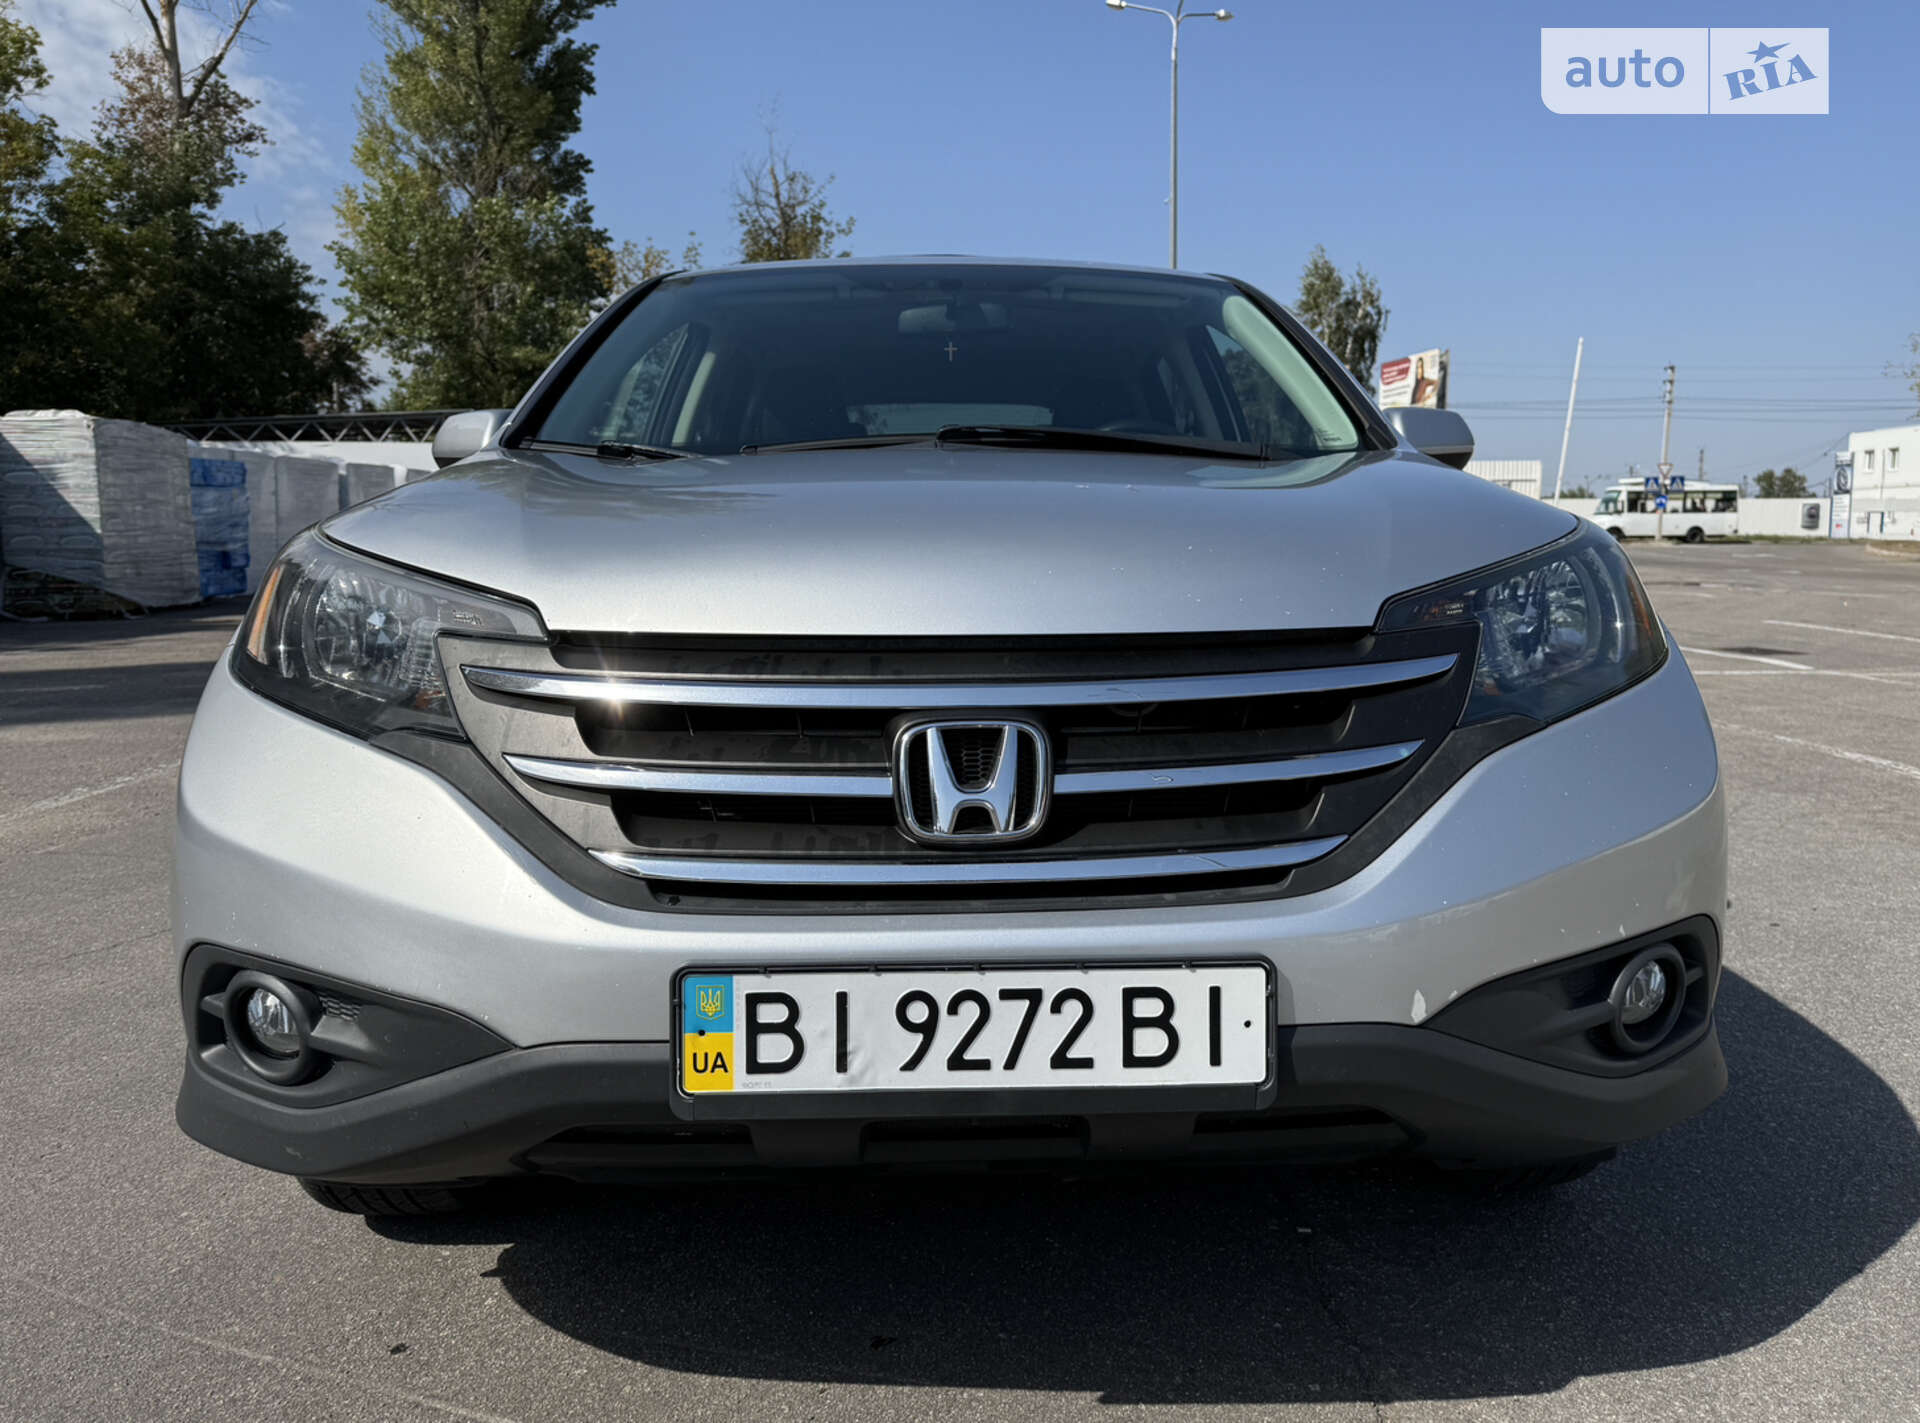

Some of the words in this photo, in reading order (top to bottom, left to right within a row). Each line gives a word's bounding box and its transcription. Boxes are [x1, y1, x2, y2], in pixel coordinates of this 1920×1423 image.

[745, 991, 848, 1075] BI
[895, 987, 1094, 1072] 9272
[1122, 985, 1222, 1069] BI
[692, 1051, 729, 1074] UA
